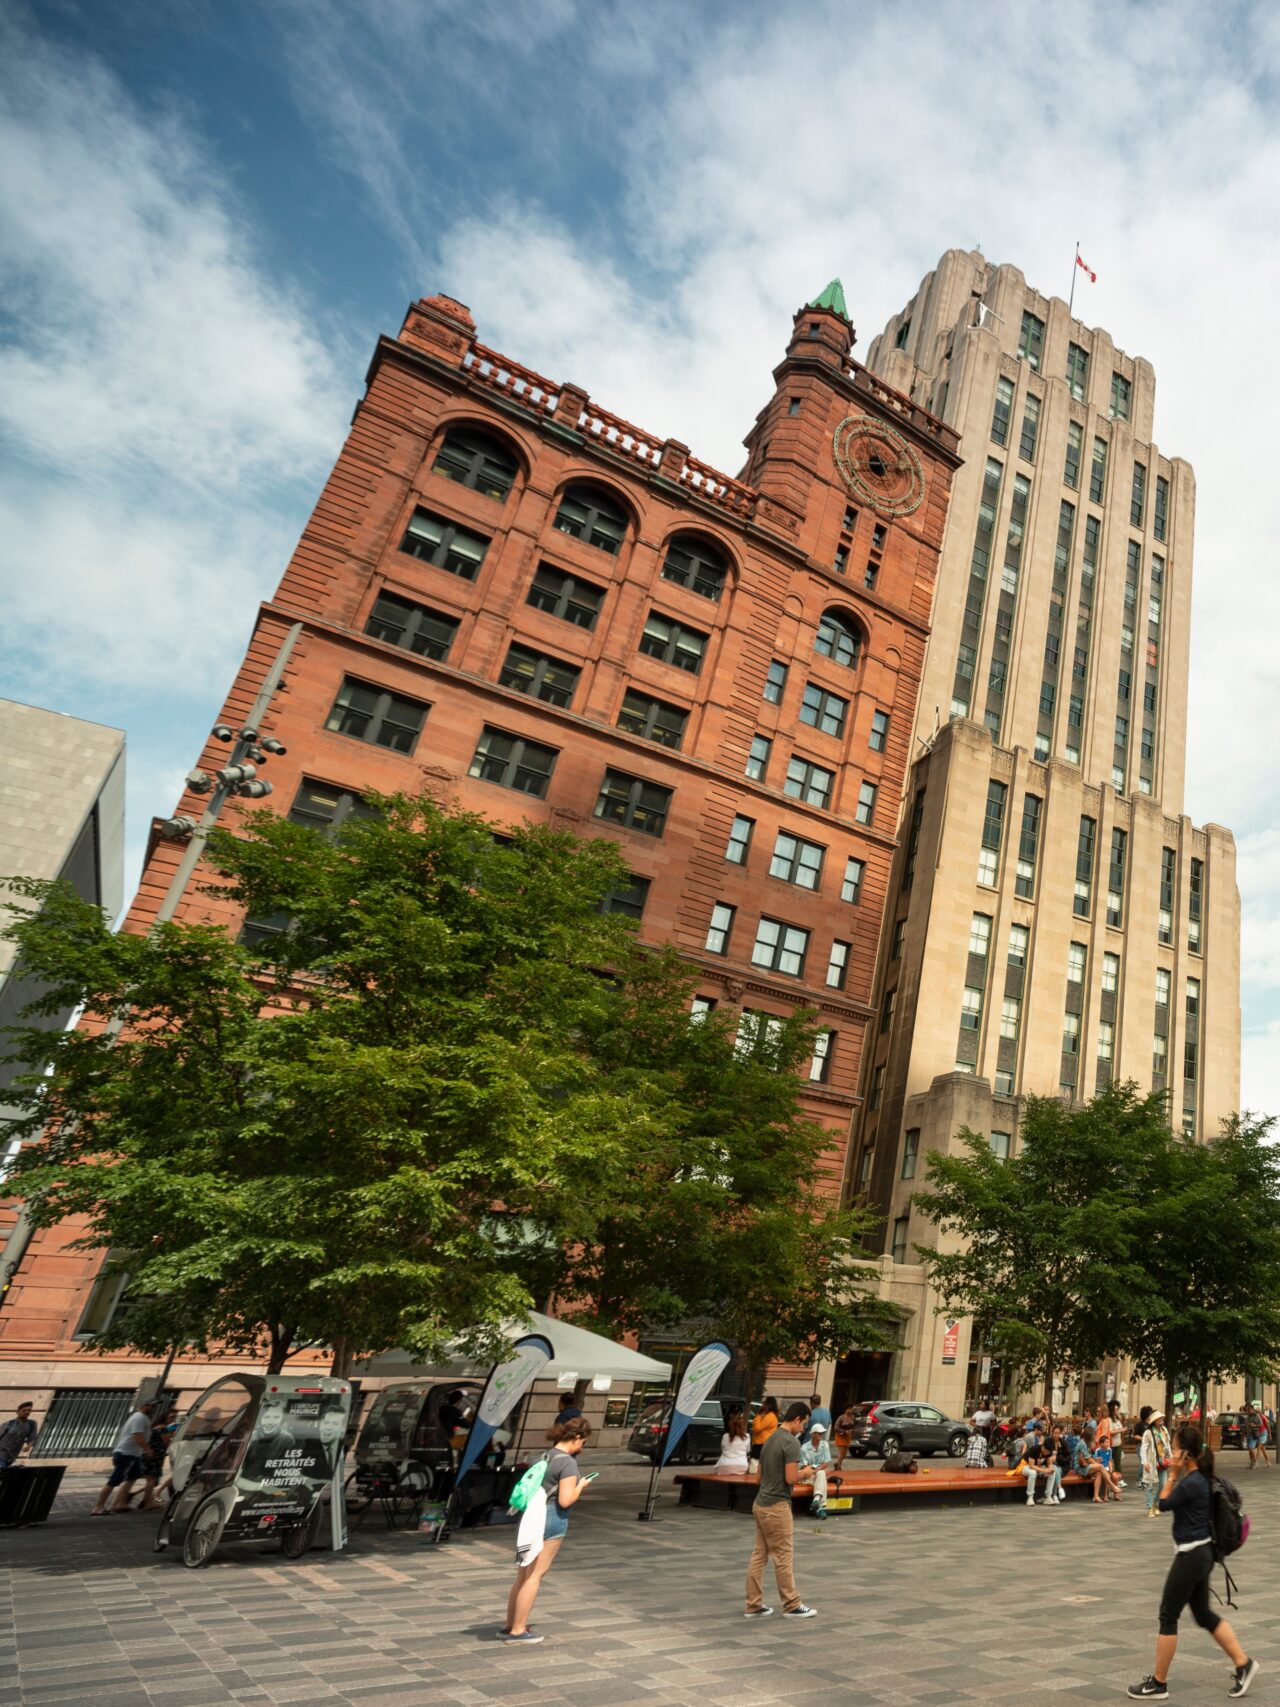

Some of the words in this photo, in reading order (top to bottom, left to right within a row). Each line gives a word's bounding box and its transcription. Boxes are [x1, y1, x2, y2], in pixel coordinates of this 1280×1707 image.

[285, 1449, 303, 1457] LES
[265, 1457, 316, 1467] RETRAITÉS
[274, 1468, 301, 1477] NOUS
[261, 1478, 307, 1487] HABITENT
